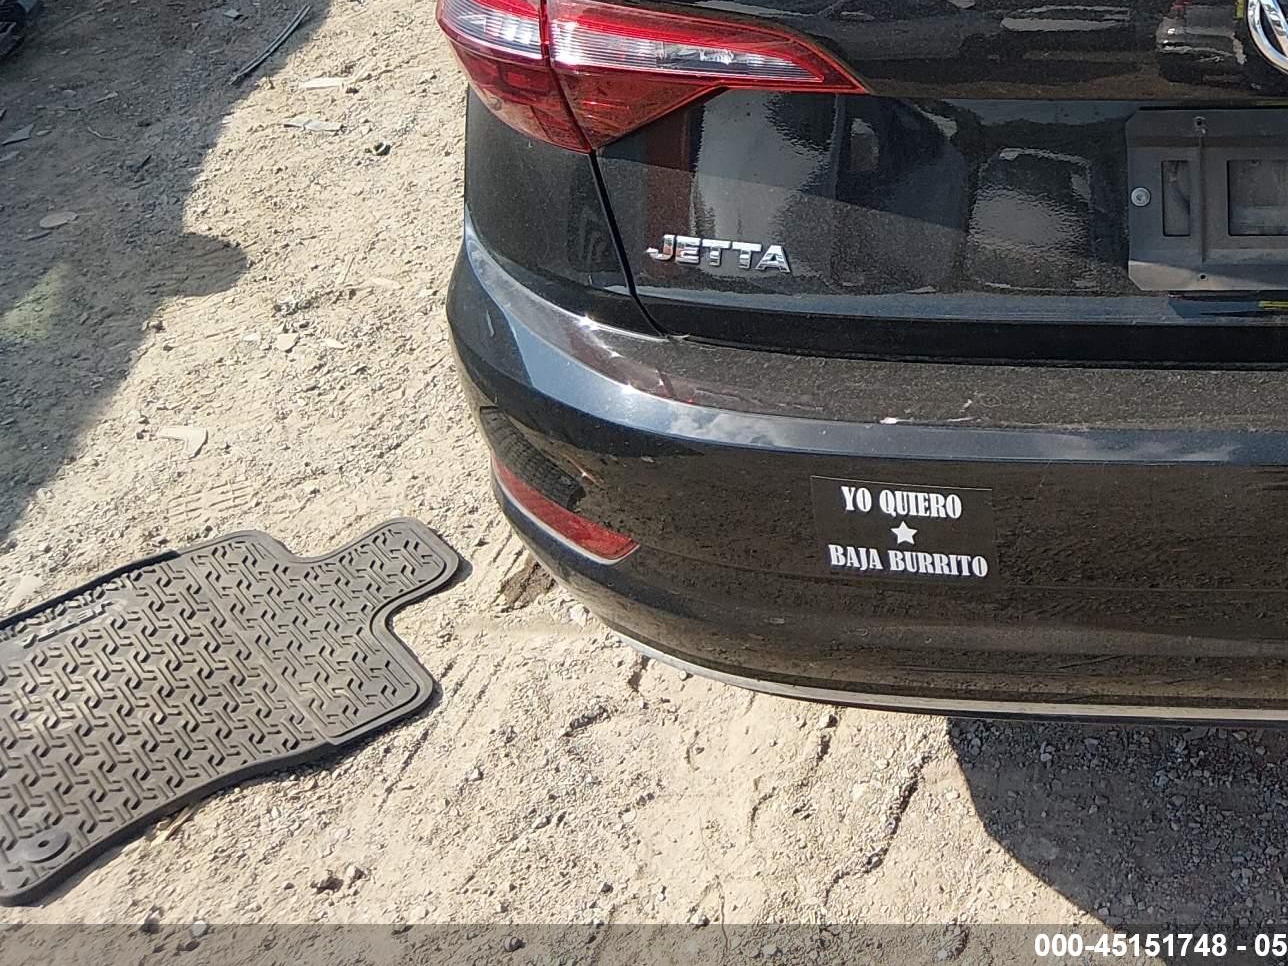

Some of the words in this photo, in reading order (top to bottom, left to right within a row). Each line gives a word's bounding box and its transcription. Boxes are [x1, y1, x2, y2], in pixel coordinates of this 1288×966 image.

[645, 234, 792, 273] JETTA
[841, 486, 872, 513] YO
[879, 489, 963, 519] QUIERO
[828, 545, 884, 571] BAJA
[887, 550, 989, 577] BURRITO
